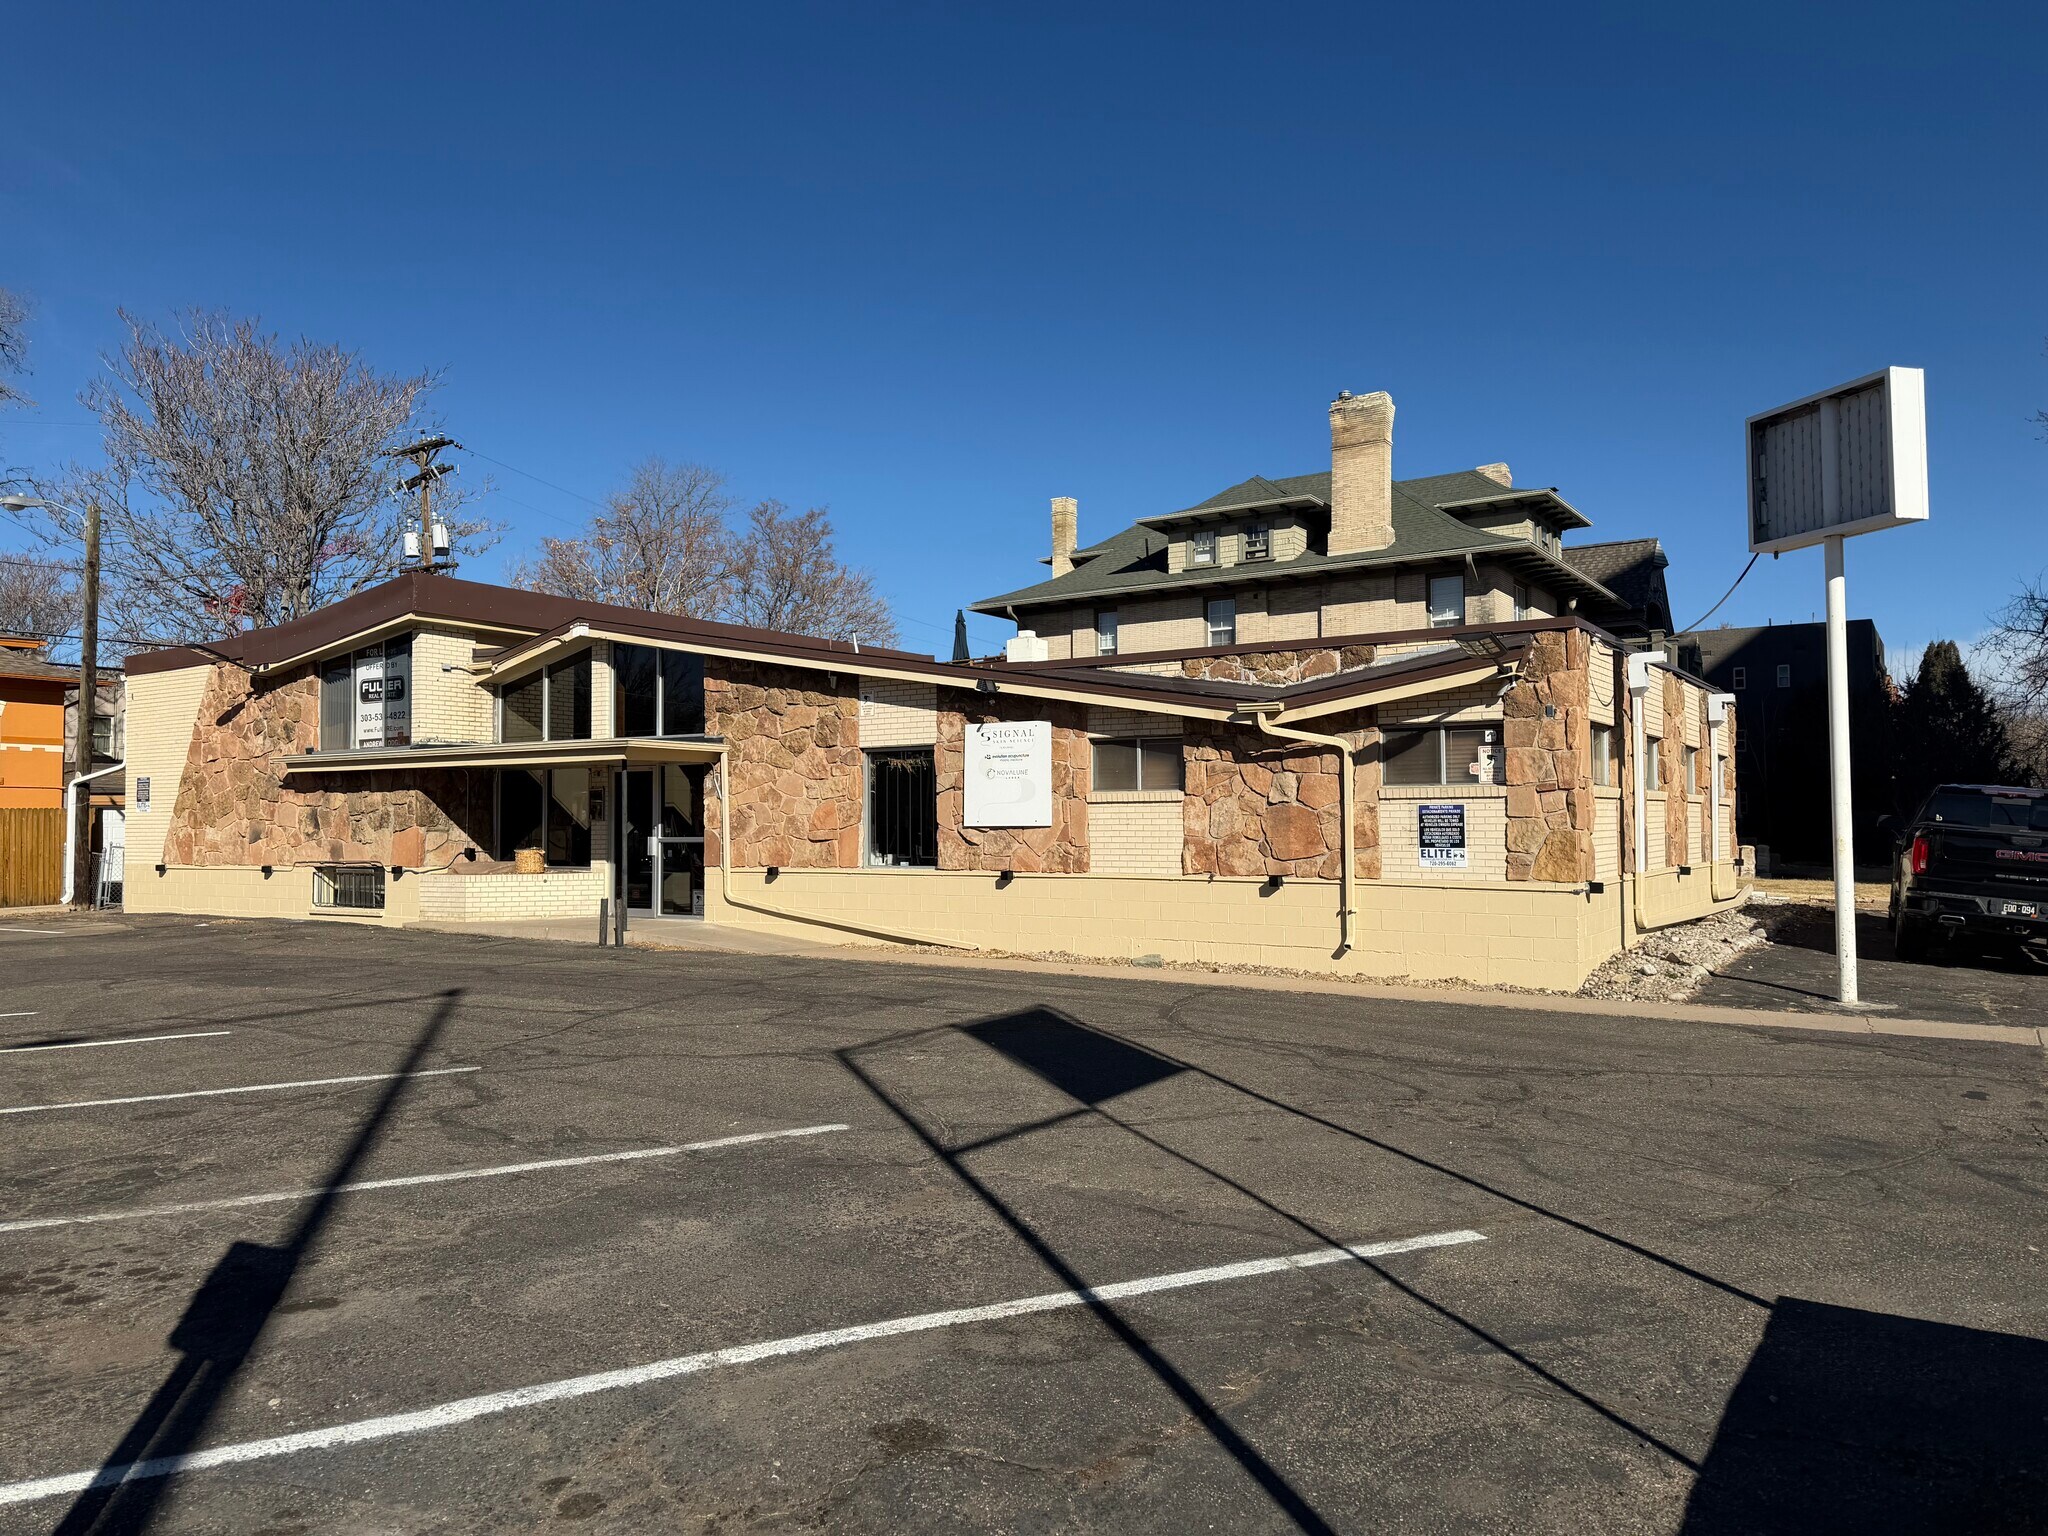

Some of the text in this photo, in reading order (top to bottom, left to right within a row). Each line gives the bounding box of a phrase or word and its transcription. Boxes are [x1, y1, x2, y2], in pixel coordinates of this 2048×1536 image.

[362, 680, 402, 692] FULER
[360, 711, 406, 722] 303-53-4822
[992, 729, 1034, 738] SIGNAL
[1421, 849, 1452, 858] ELITE
[1996, 850, 2048, 862] GMC
